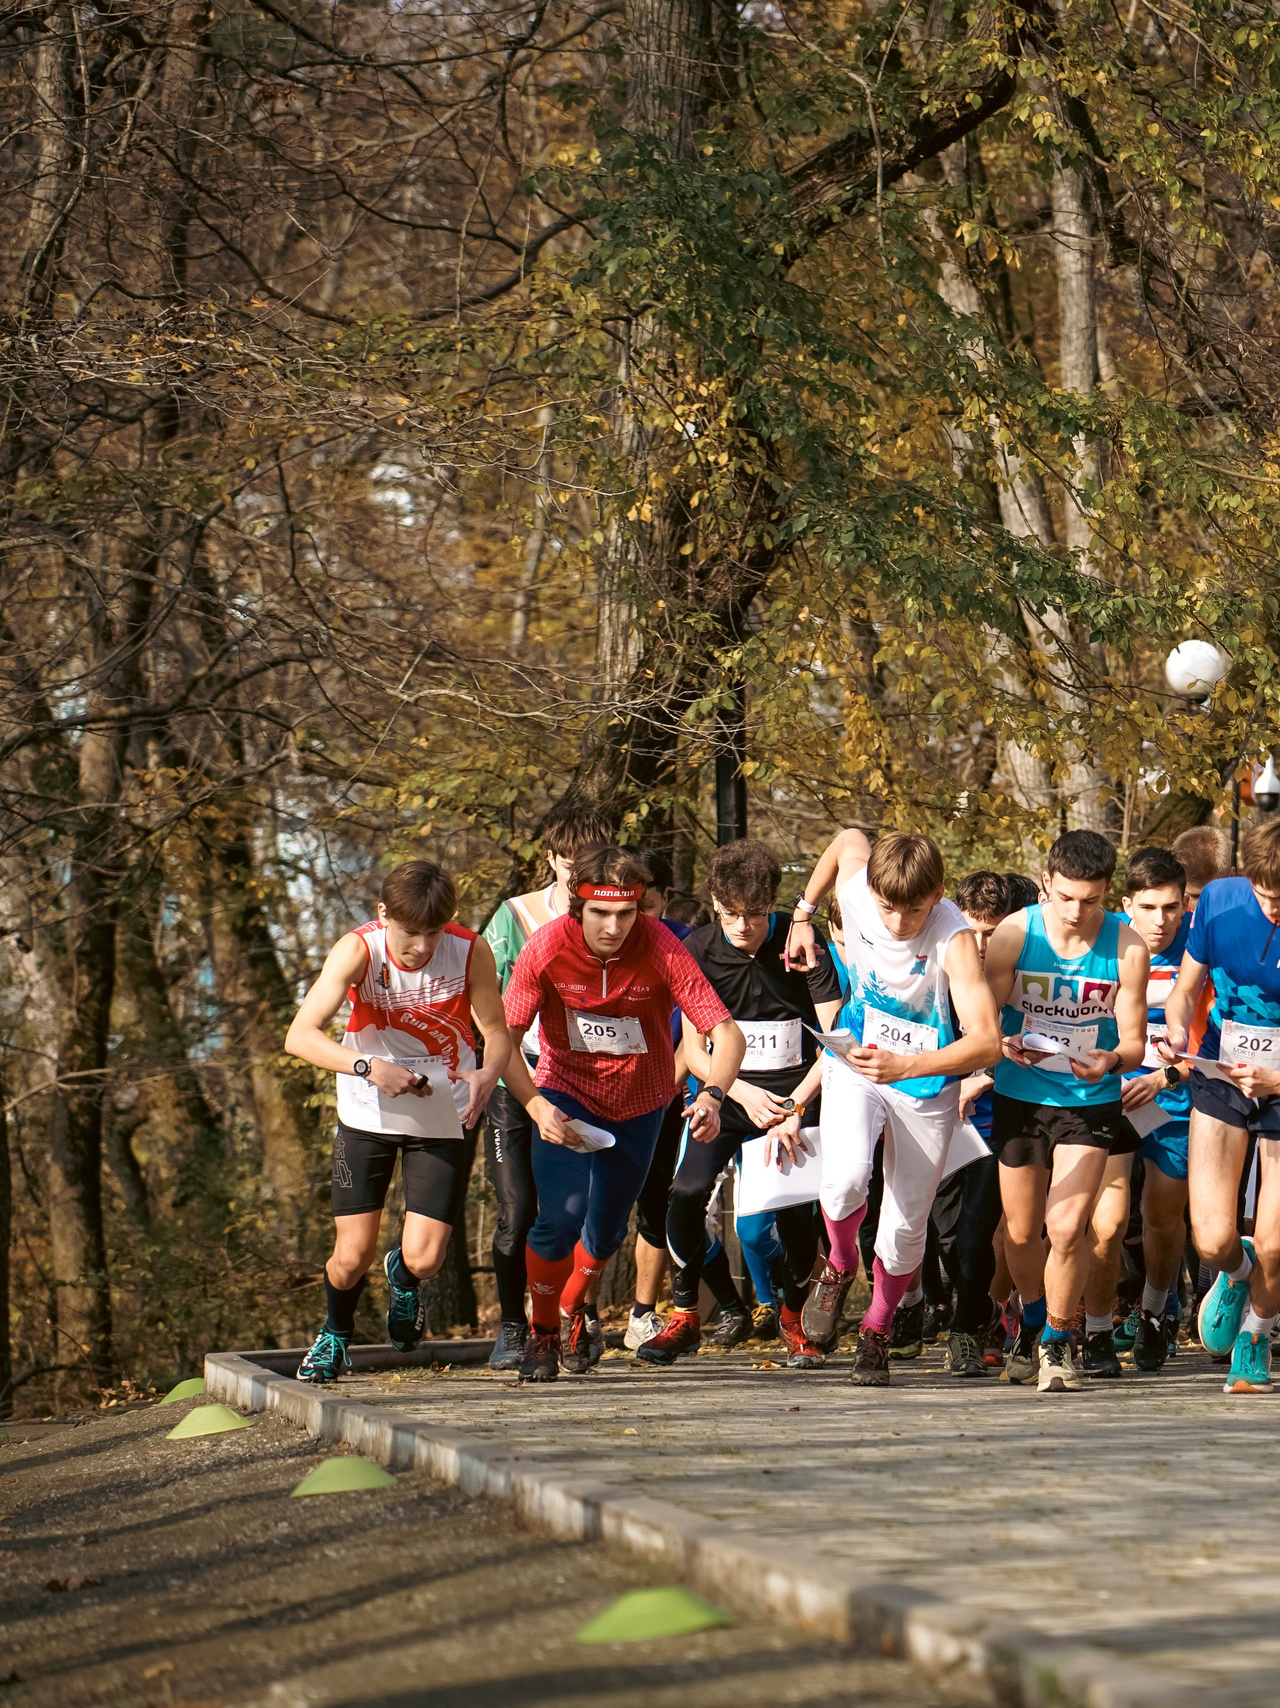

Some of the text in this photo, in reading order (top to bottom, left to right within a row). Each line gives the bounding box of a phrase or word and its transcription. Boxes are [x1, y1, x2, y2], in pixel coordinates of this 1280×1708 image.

[400, 1012, 429, 1031] Run
[428, 1030, 451, 1045] and
[582, 1022, 617, 1038] 205
[880, 1023, 912, 1045] 204
[746, 1034, 777, 1049] 211
[785, 1040, 790, 1049] 1
[918, 1042, 923, 1050] 1
[1237, 1035, 1273, 1052] 202
